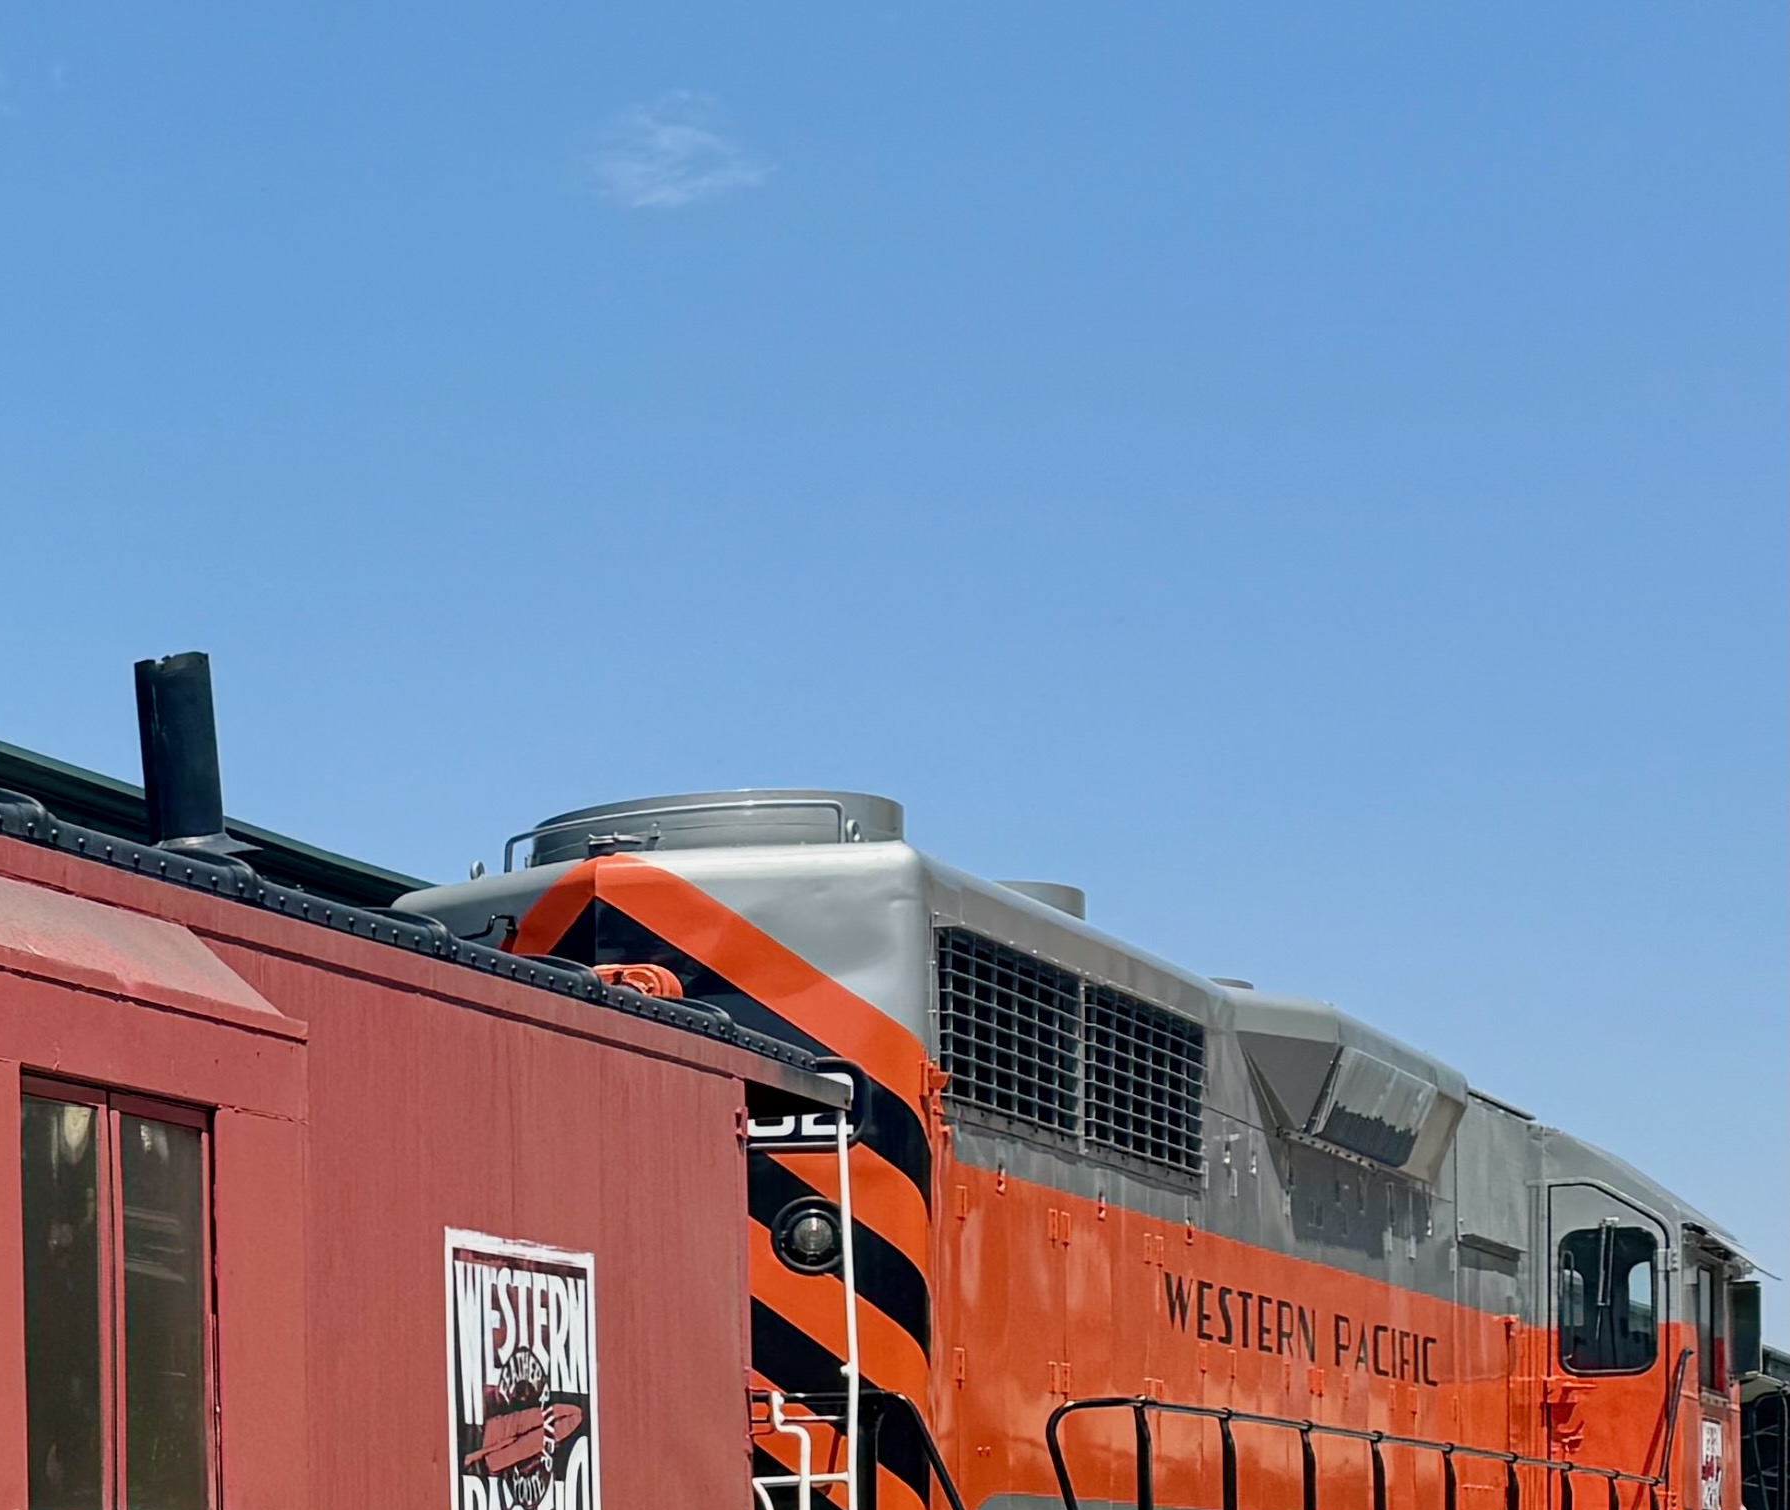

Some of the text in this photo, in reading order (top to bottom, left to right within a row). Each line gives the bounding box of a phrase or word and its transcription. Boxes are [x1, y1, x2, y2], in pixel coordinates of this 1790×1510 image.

[454, 1260, 590, 1426] WESTERN
[1164, 1271, 1439, 1387] WESTERN PACIFIC
